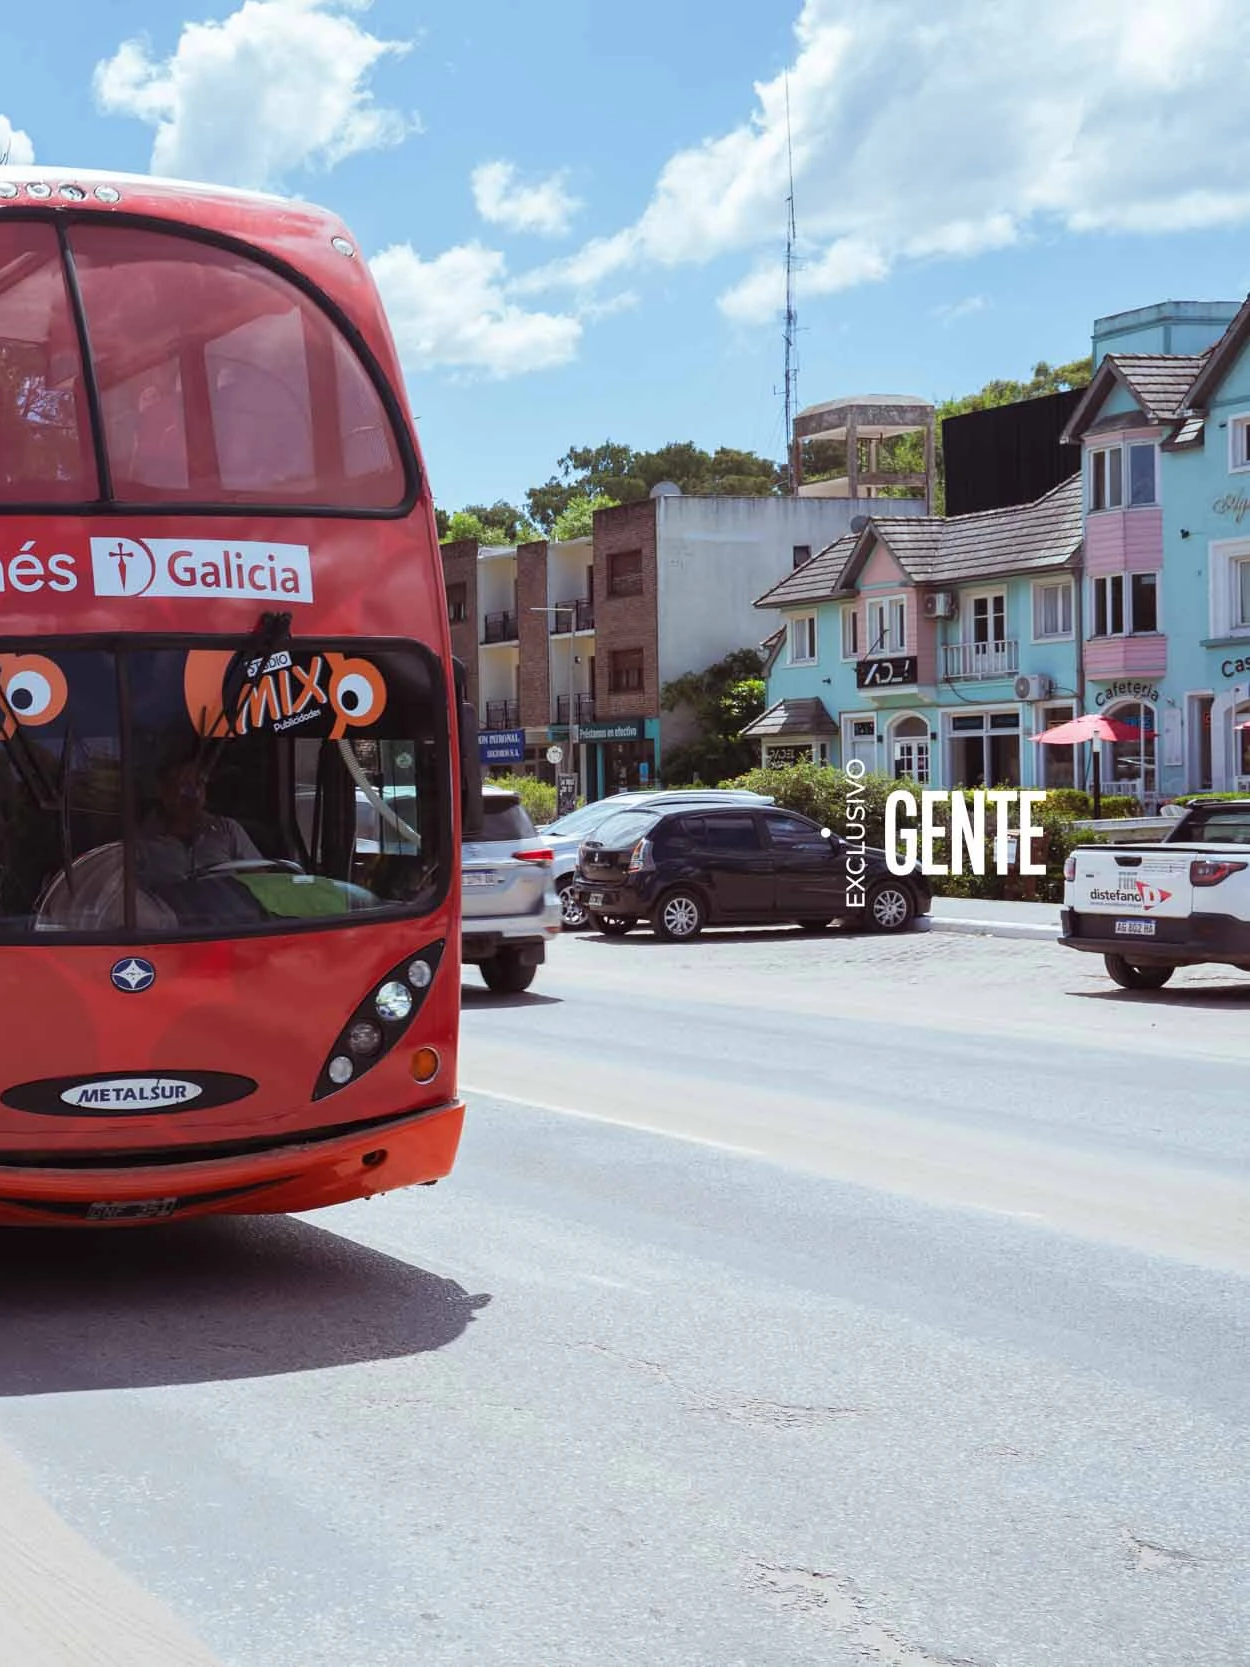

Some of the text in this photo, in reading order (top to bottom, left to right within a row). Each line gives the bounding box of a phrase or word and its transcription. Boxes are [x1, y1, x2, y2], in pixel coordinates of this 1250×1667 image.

[167, 550, 300, 593] Galicia
[273, 708, 322, 733] Publicidades
[615, 726, 637, 737] efectivo
[1090, 888, 1142, 902] distefano
[78, 1085, 187, 1103] METALSUR
